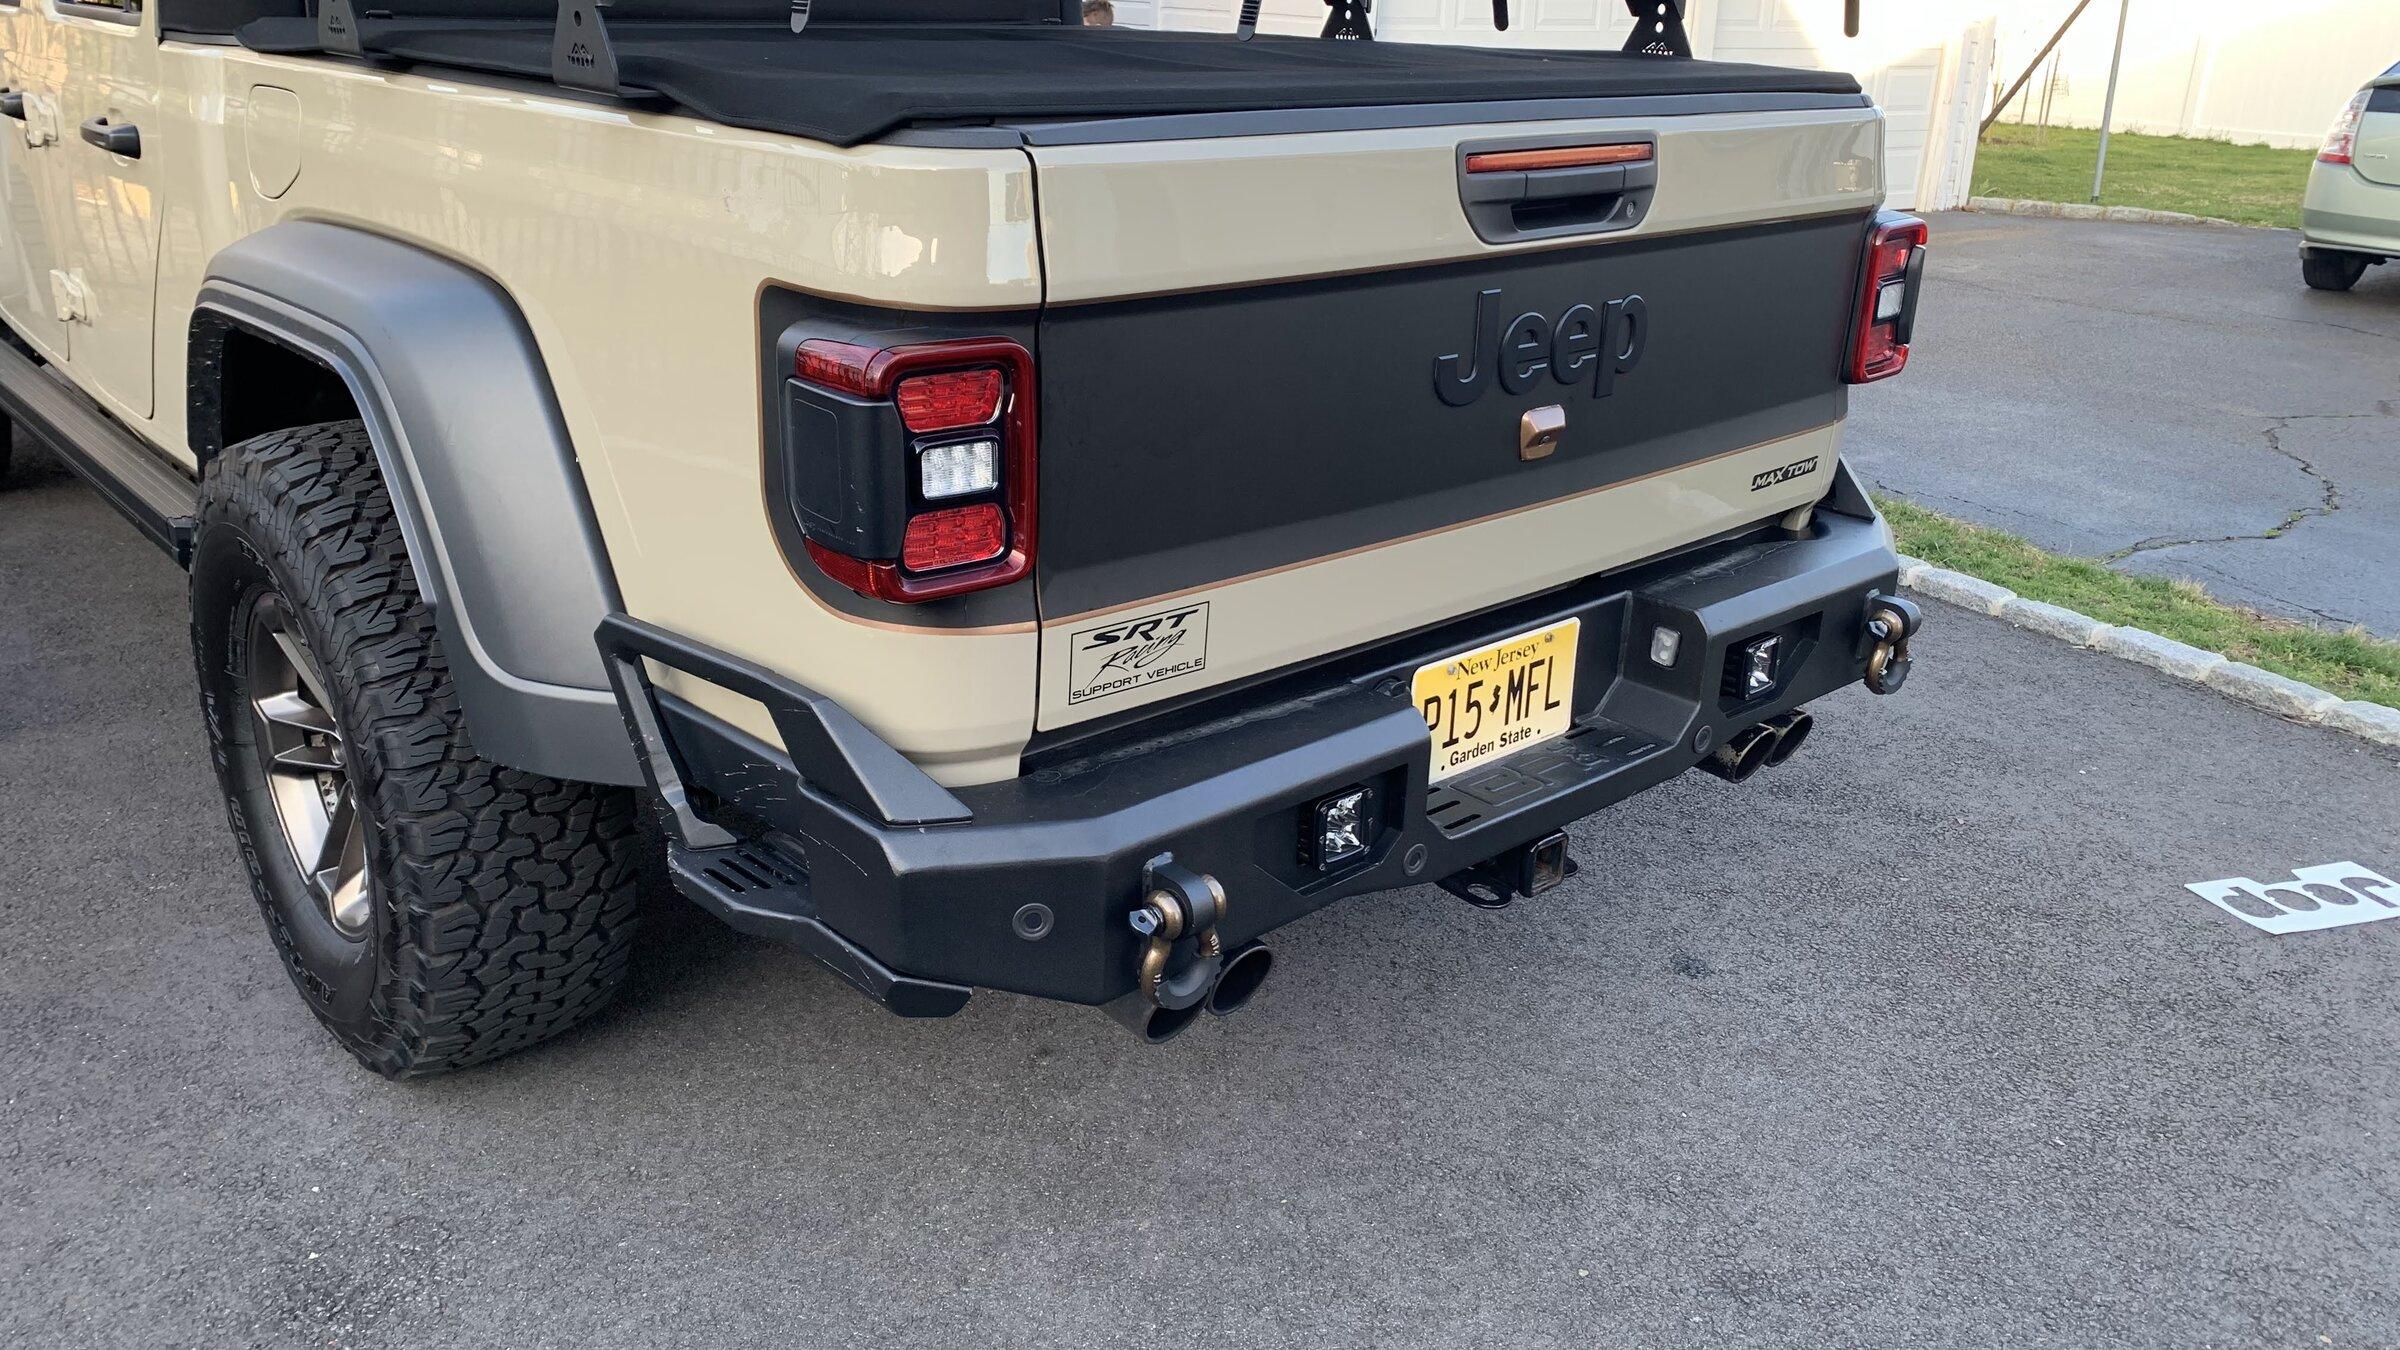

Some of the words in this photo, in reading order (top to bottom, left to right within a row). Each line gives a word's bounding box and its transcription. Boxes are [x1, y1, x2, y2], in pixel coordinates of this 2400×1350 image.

[1434, 288, 1648, 407] Jeep
[1751, 463, 1790, 486] MAX
[1788, 459, 1818, 478] TOW
[1082, 608, 1200, 651] SRT
[1072, 674, 1142, 700] SUPPORT
[1146, 657, 1203, 680] VEHICLE
[1084, 628, 1188, 690] Racing
[1456, 657, 1493, 681] New
[1493, 642, 1540, 671] Jersey
[1449, 740, 1495, 767] Garden
[1499, 725, 1532, 748] State
